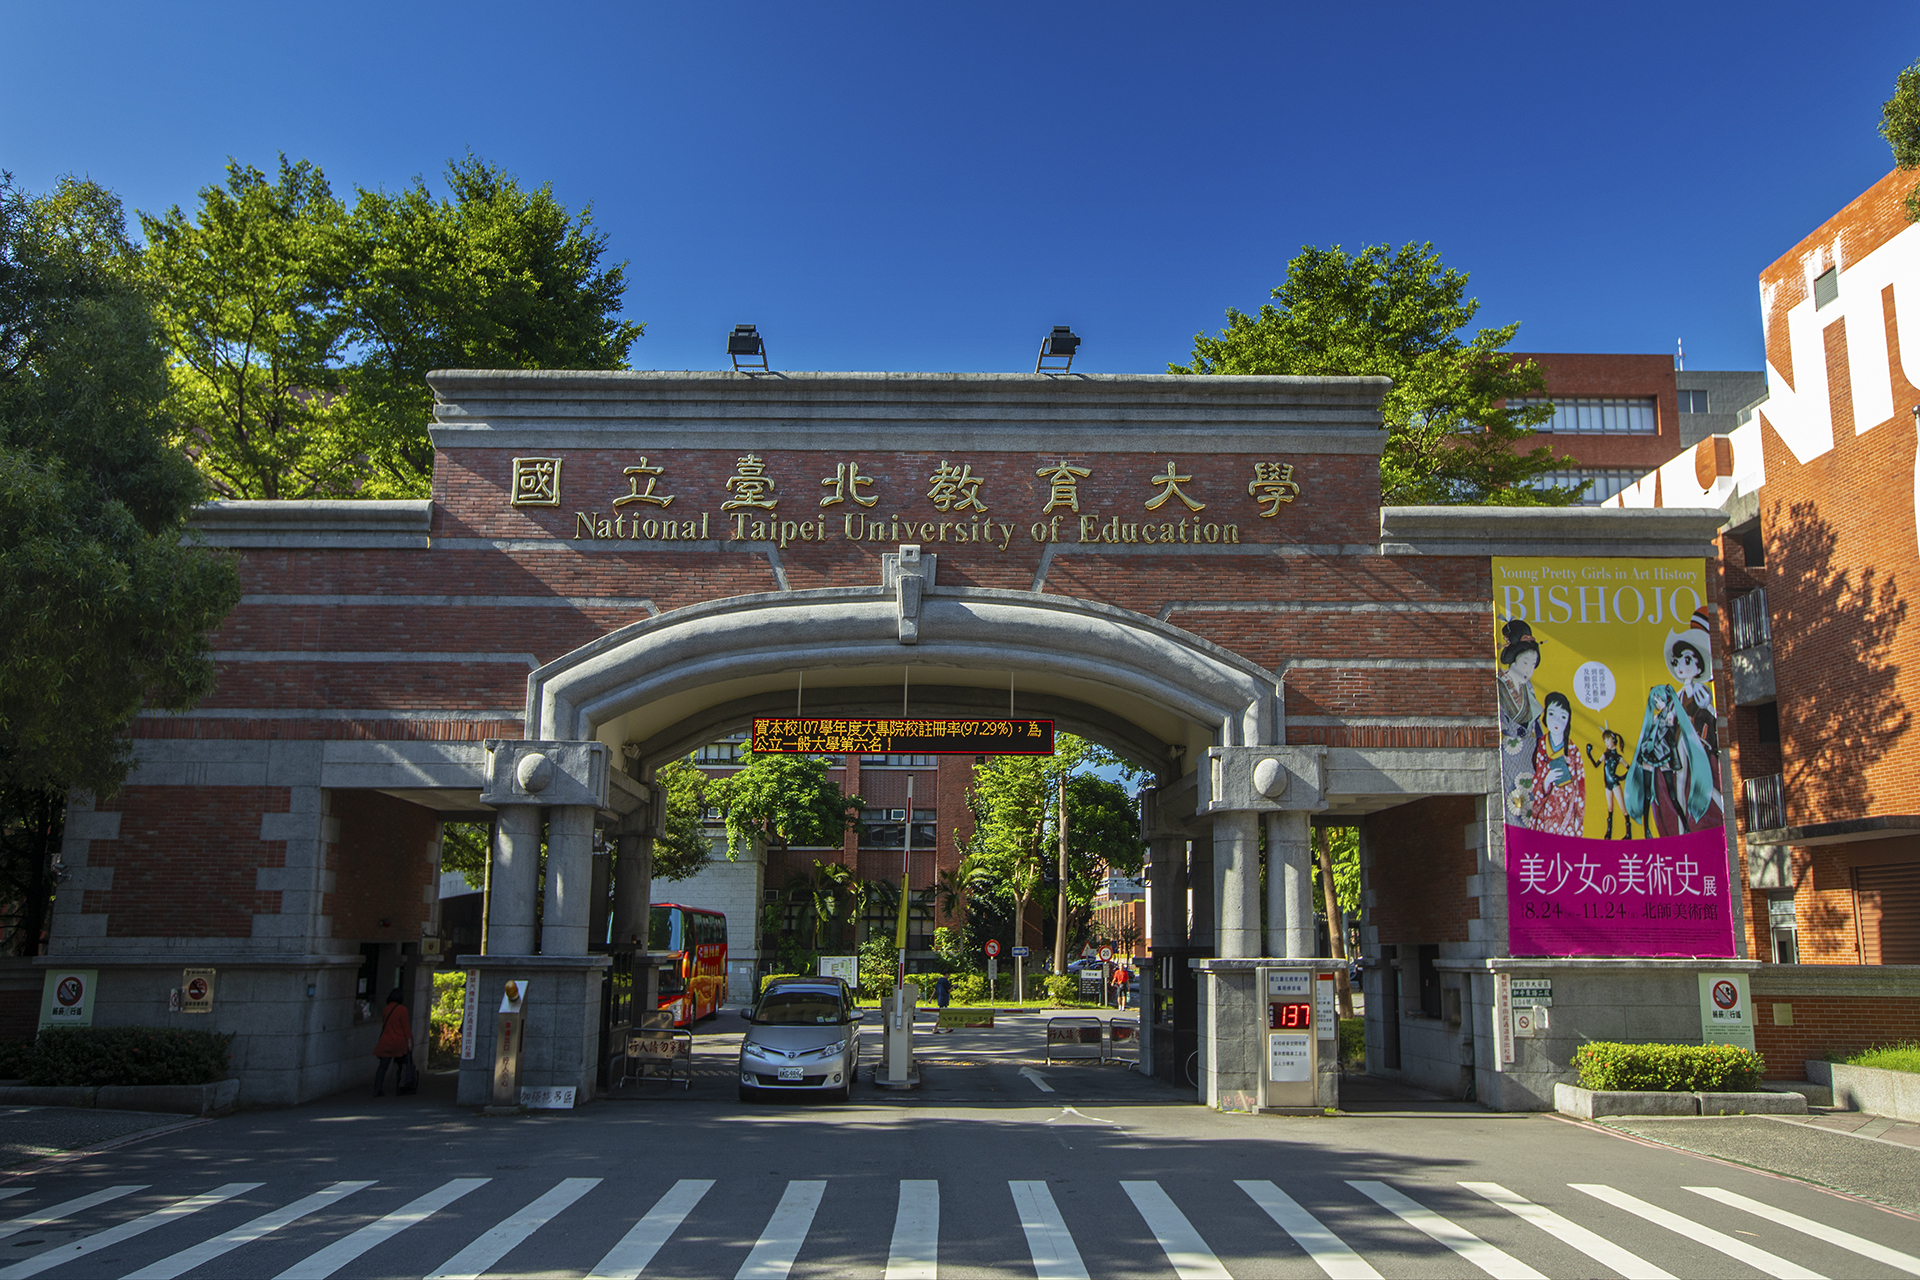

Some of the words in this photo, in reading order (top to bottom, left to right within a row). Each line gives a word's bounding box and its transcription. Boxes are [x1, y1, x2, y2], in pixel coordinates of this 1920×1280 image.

[510, 453, 1300, 518] 國立臺北教育大學
[574, 511, 710, 541] National
[729, 511, 826, 549] Taipei
[844, 512, 1016, 551] University
[1031, 515, 1064, 543] of
[1078, 514, 1240, 544] Education
[1500, 566, 1538, 583] Young
[1542, 566, 1578, 583] Pretty
[1582, 566, 1611, 580] Girls
[1615, 567, 1627, 580] in
[1631, 567, 1650, 580] Art
[1654, 567, 1698, 584] History
[1500, 585, 1702, 625] BISHOJO
[1519, 852, 1718, 897] 美少女の美術史展
[1525, 901, 1563, 919] 8.24
[1642, 901, 1719, 921] 北師美術館
[1102, 949, 1109, 957] 20
[1282, 1004, 1311, 1027] 137
[629, 1040, 687, 1055] 行人請勿穿越
